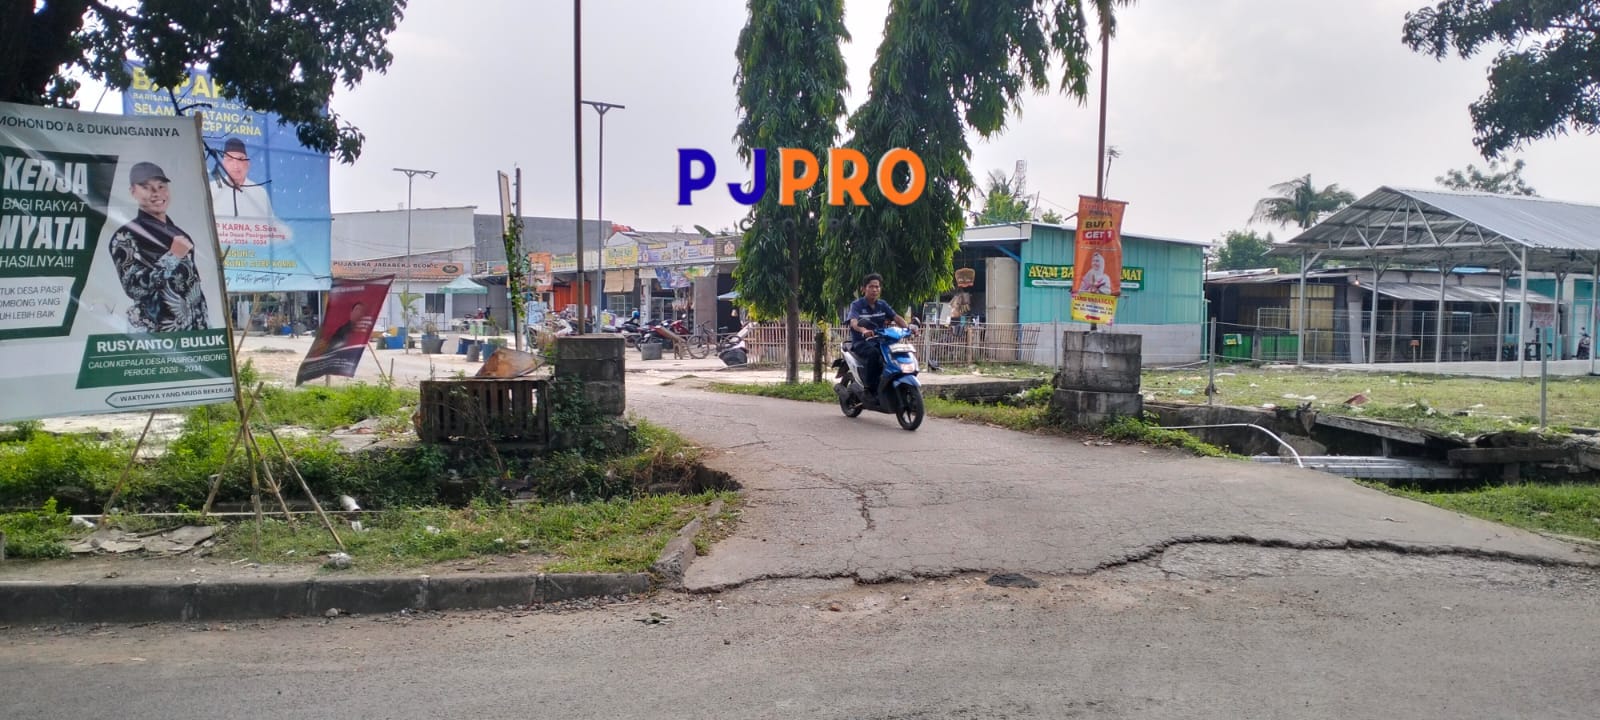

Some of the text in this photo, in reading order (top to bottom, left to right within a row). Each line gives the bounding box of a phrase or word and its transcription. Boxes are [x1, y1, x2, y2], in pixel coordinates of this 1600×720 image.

[134, 102, 190, 117] SELAMT
[193, 109, 240, 124] ATANG
[0, 116, 44, 129] MOHON
[77, 124, 85, 133] &
[87, 124, 180, 137] DUKUNGANNYA
[201, 121, 262, 136] CEP KARNA
[3, 156, 88, 194] KERJA
[2, 197, 87, 212] BAGI RAKYAT
[1085, 220, 1106, 229] BUY
[0, 215, 86, 250] NYATA
[1084, 230, 1113, 239] GET 1
[0, 254, 74, 269] HASILNYA!!!
[1028, 265, 1058, 278] AYAM
[1061, 266, 1074, 279] BA
[0, 285, 65, 296] TUK DESA PASIR
[37, 297, 62, 306] YANG
[0, 310, 56, 321] UH LEBIH BAIK
[96, 338, 173, 353] RUSYANTO
[181, 334, 225, 348] BULUK
[88, 353, 228, 370] CALON KEPALA DESA PASIRGOMBONG
[123, 367, 157, 377] PERIODE
[119, 393, 161, 402] WAKTUNYA
[161, 391, 181, 400] YANG
[203, 387, 233, 396] BEKERJA
